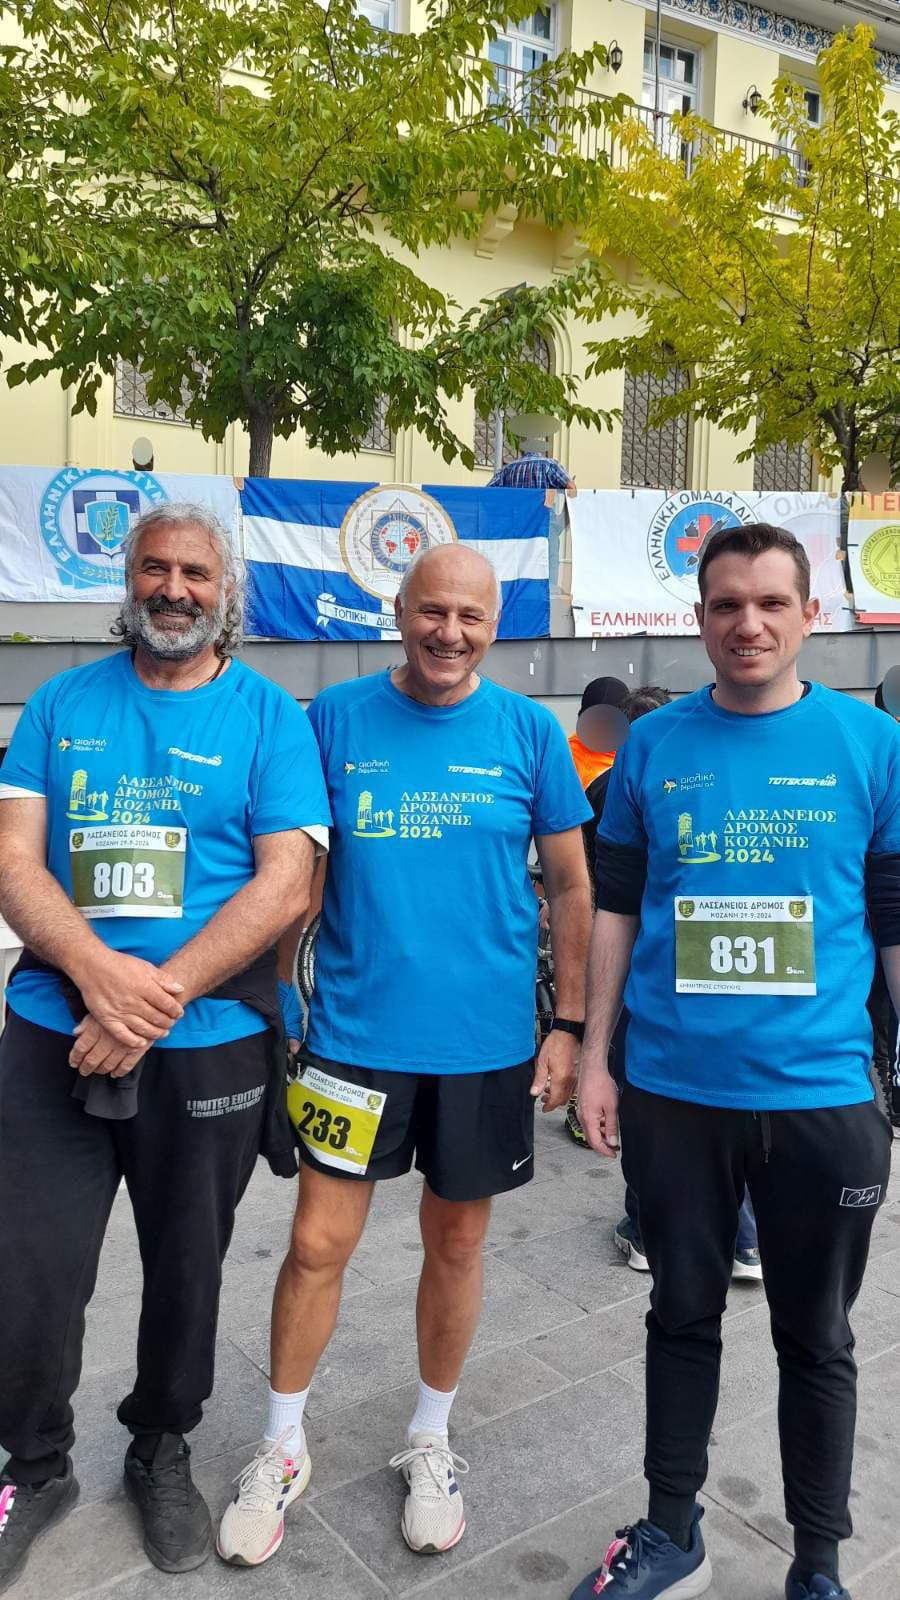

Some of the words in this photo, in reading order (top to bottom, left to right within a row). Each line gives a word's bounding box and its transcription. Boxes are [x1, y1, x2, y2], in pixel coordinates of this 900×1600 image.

[651, 502, 678, 581] ΕΛΛΗΝΙΚΗ
[333, 607, 367, 622] ΤΟΠΙΚΗ
[591, 612, 677, 627] ΕΛΛΗΝΙΚΗ
[118, 774, 203, 796] ΛΑΣΣΑΝΕΙΟΣ
[114, 787, 173, 799] ΔΡΟΜΟΣ
[401, 792, 495, 804] ΛΑΣΣΑΝΕΙΟΣ
[113, 798, 181, 811] ΚΟΖΑΝΗΣ
[400, 803, 462, 814] ΔΡΟΜΟΣ
[111, 810, 151, 825] 2024
[400, 814, 472, 826] ΚΟΖΑΝΗΣ
[723, 809, 837, 823] ΛΑΣΣΑΝΕΙΟΣ
[400, 826, 443, 839] 2024
[723, 822, 798, 834] ΔΡΟΜΟΣ
[87, 830, 128, 840] ΛΑΣΣΑΝΕΙΟΣ
[130, 831, 161, 840] ΔΡΟΜΟΣ
[724, 836, 809, 848] ΚΟΖΑΝΗΣ
[725, 849, 775, 864] 2024
[94, 861, 155, 898] 803
[699, 901, 748, 910] ΛΑΣΣΑΝΕΙΟΣ
[750, 902, 785, 910] ΔΡΟΜΟΣ
[710, 911, 738, 919] ΚΟΖΑΝΗ
[710, 935, 776, 974] 831
[186, 1096, 230, 1111] LIMITED
[231, 1083, 266, 1106] EDITION
[298, 1101, 351, 1150] 233
